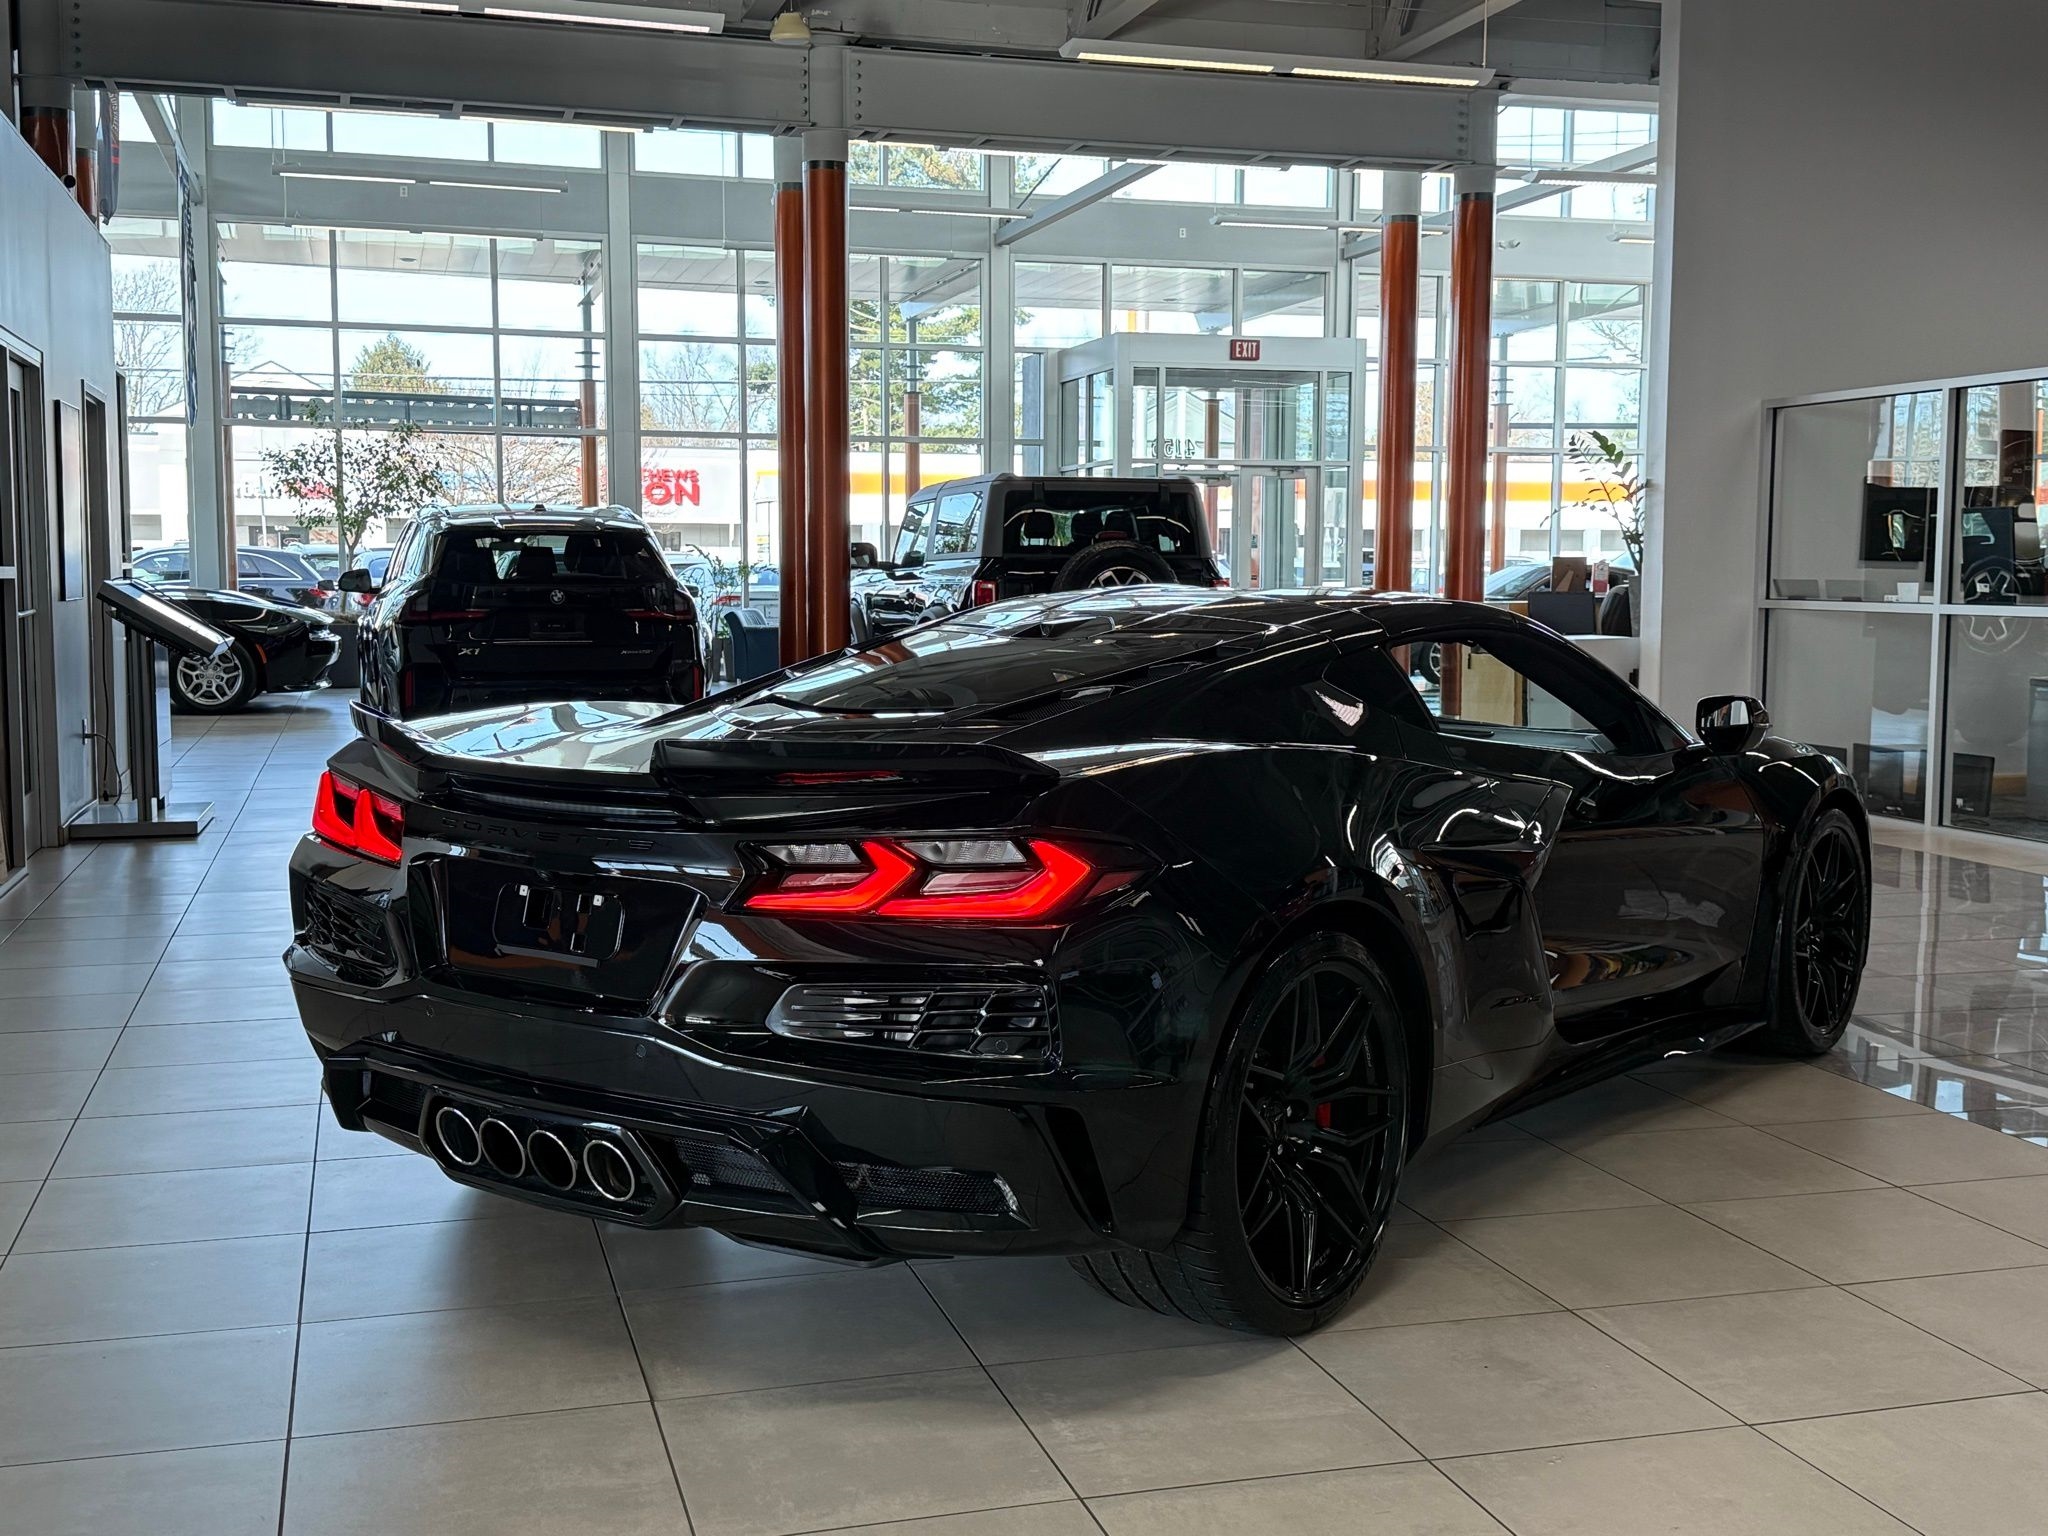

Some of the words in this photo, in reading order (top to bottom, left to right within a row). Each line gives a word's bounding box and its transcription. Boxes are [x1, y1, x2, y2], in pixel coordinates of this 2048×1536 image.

[1236, 341, 1257, 358] EXIT
[458, 648, 480, 656] X1
[442, 817, 654, 850] CORVETTE
